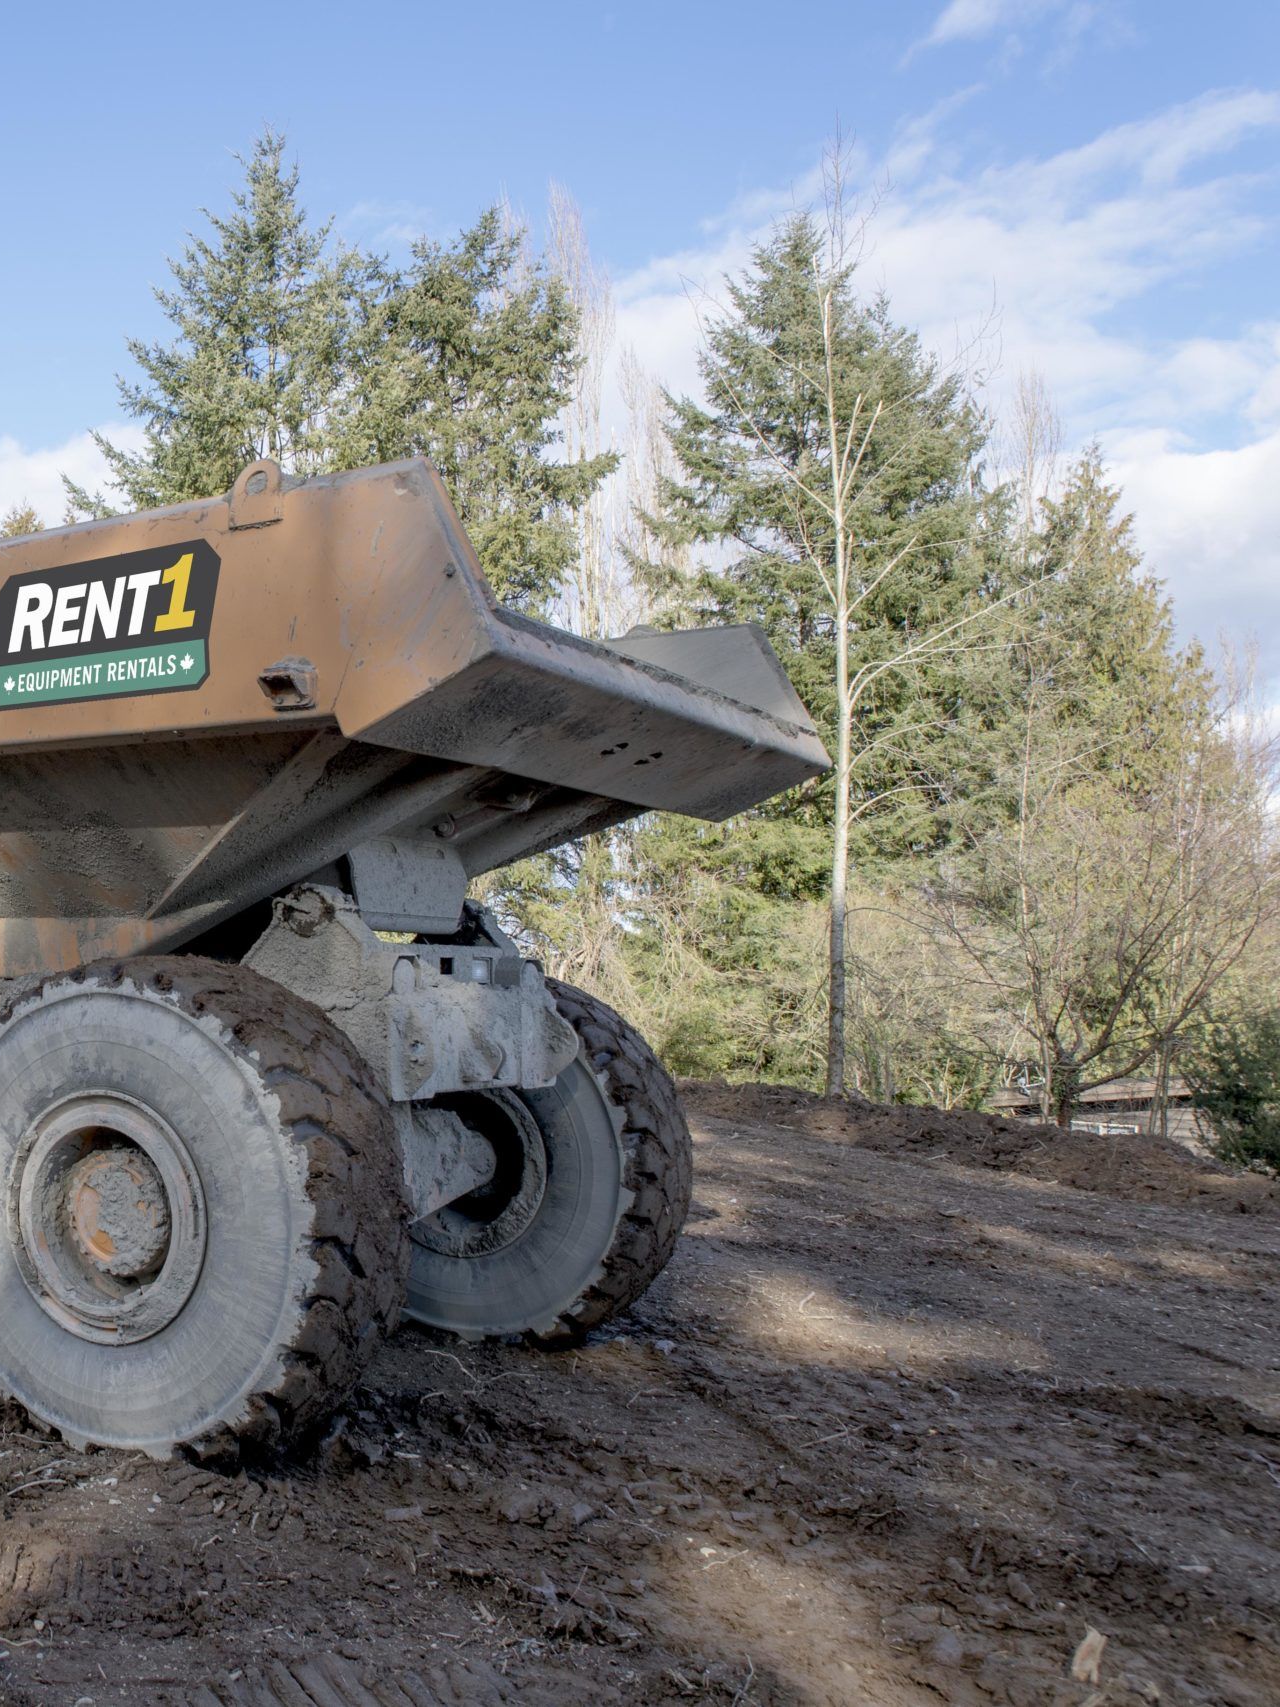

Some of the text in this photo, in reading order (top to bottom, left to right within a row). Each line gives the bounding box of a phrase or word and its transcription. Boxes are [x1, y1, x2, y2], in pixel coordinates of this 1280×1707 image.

[7, 553, 196, 653] RENT1
[17, 654, 177, 693] EQUIPMENT RENTALS
